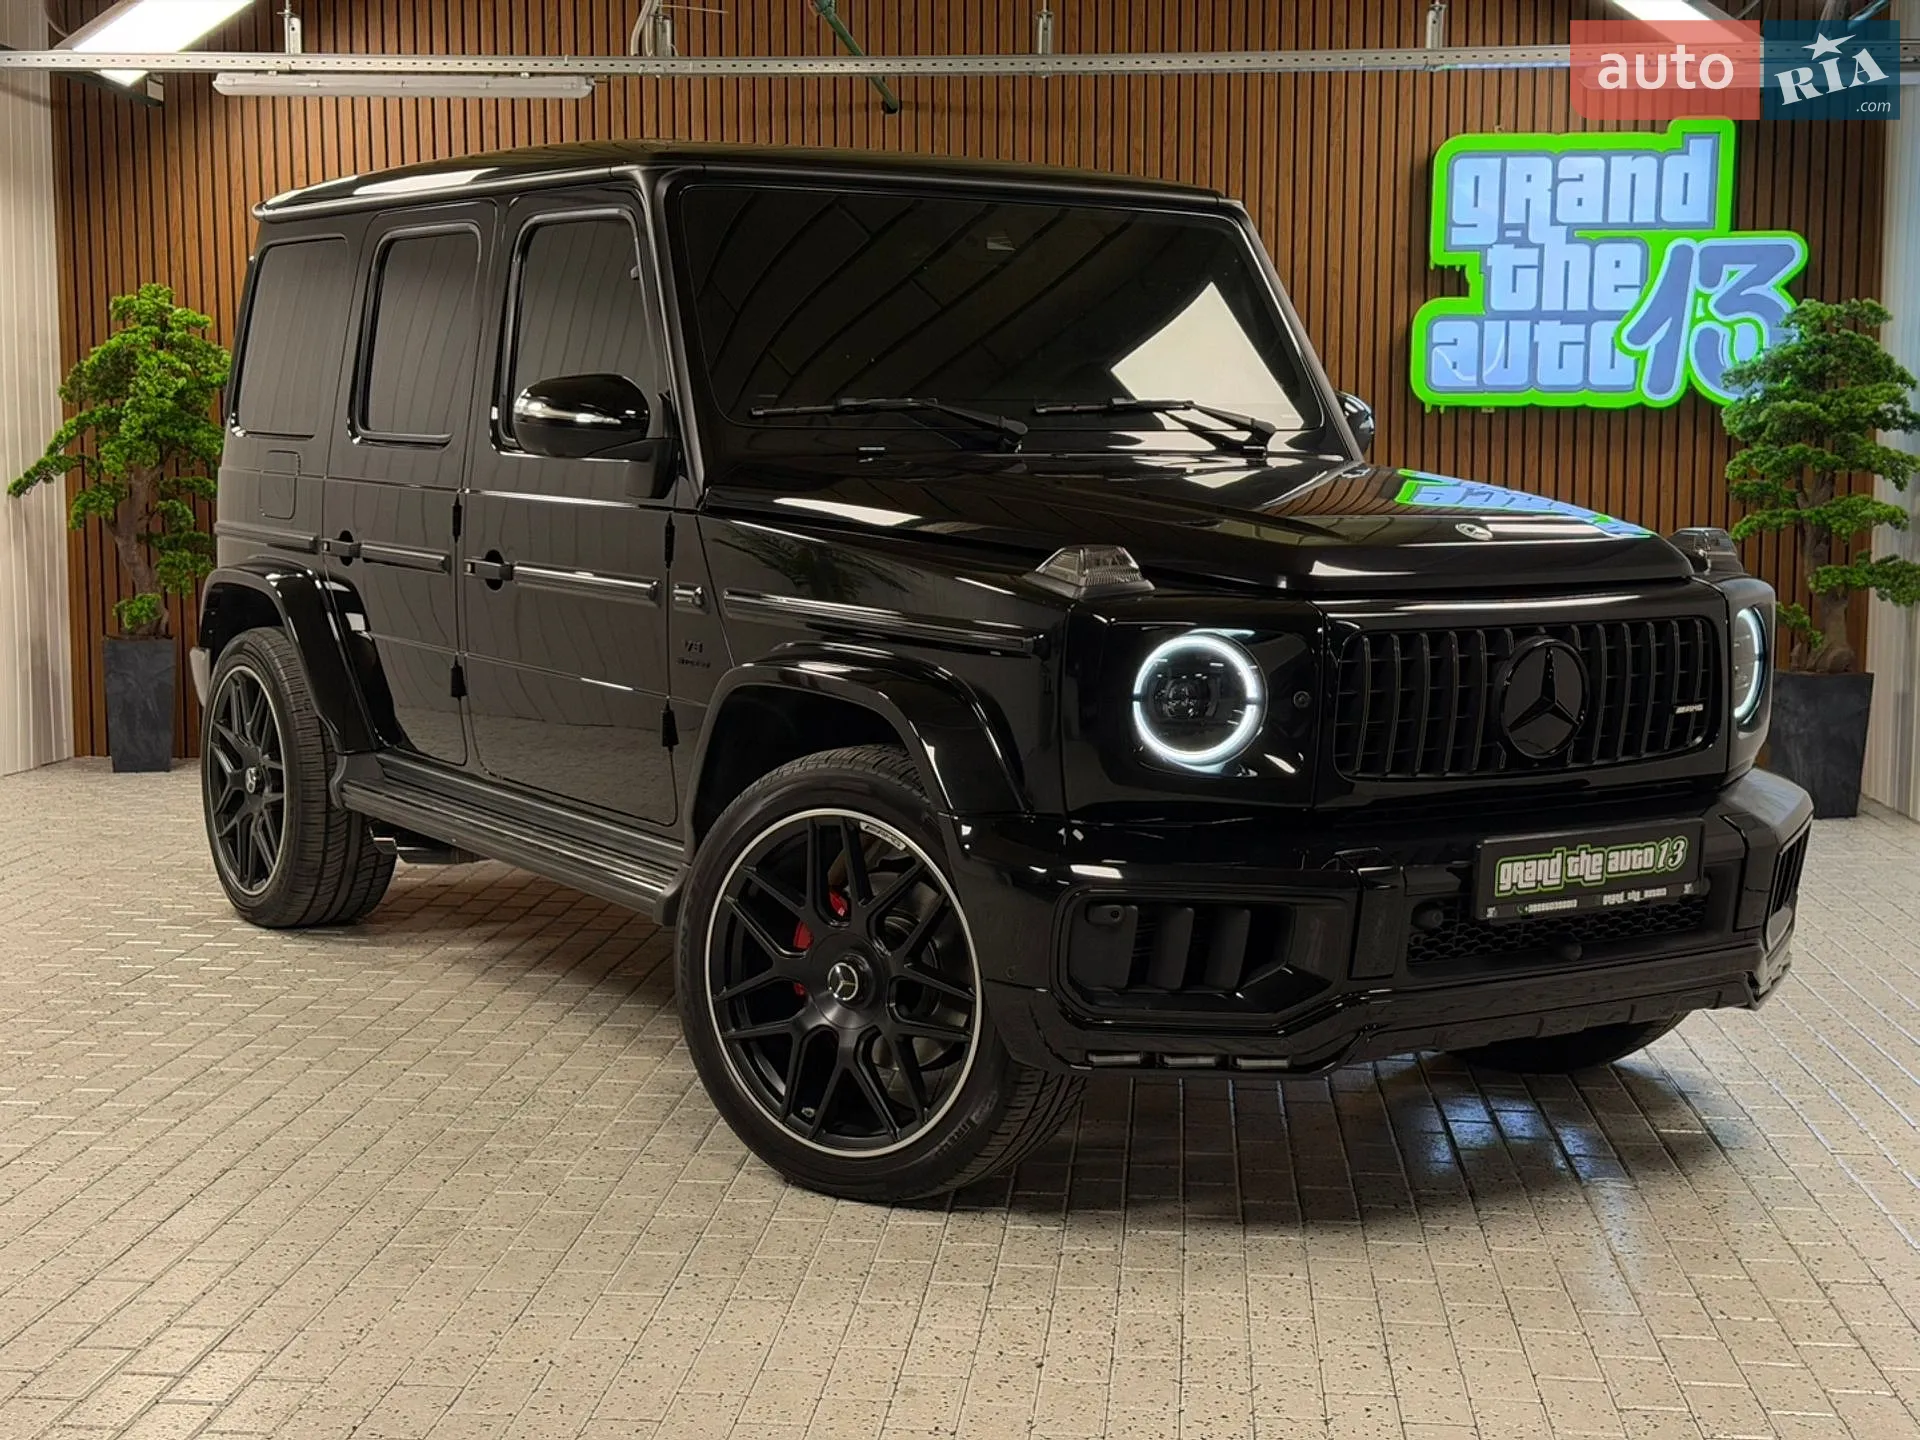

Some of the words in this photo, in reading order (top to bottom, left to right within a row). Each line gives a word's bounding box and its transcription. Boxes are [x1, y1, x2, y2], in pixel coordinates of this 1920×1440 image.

[1451, 136, 1718, 246] grand
[1430, 319, 1640, 387] auto
[1486, 227, 1644, 312] the
[1621, 236, 1803, 400] 13
[1499, 852, 1562, 891] grand
[1566, 849, 1603, 882] the
